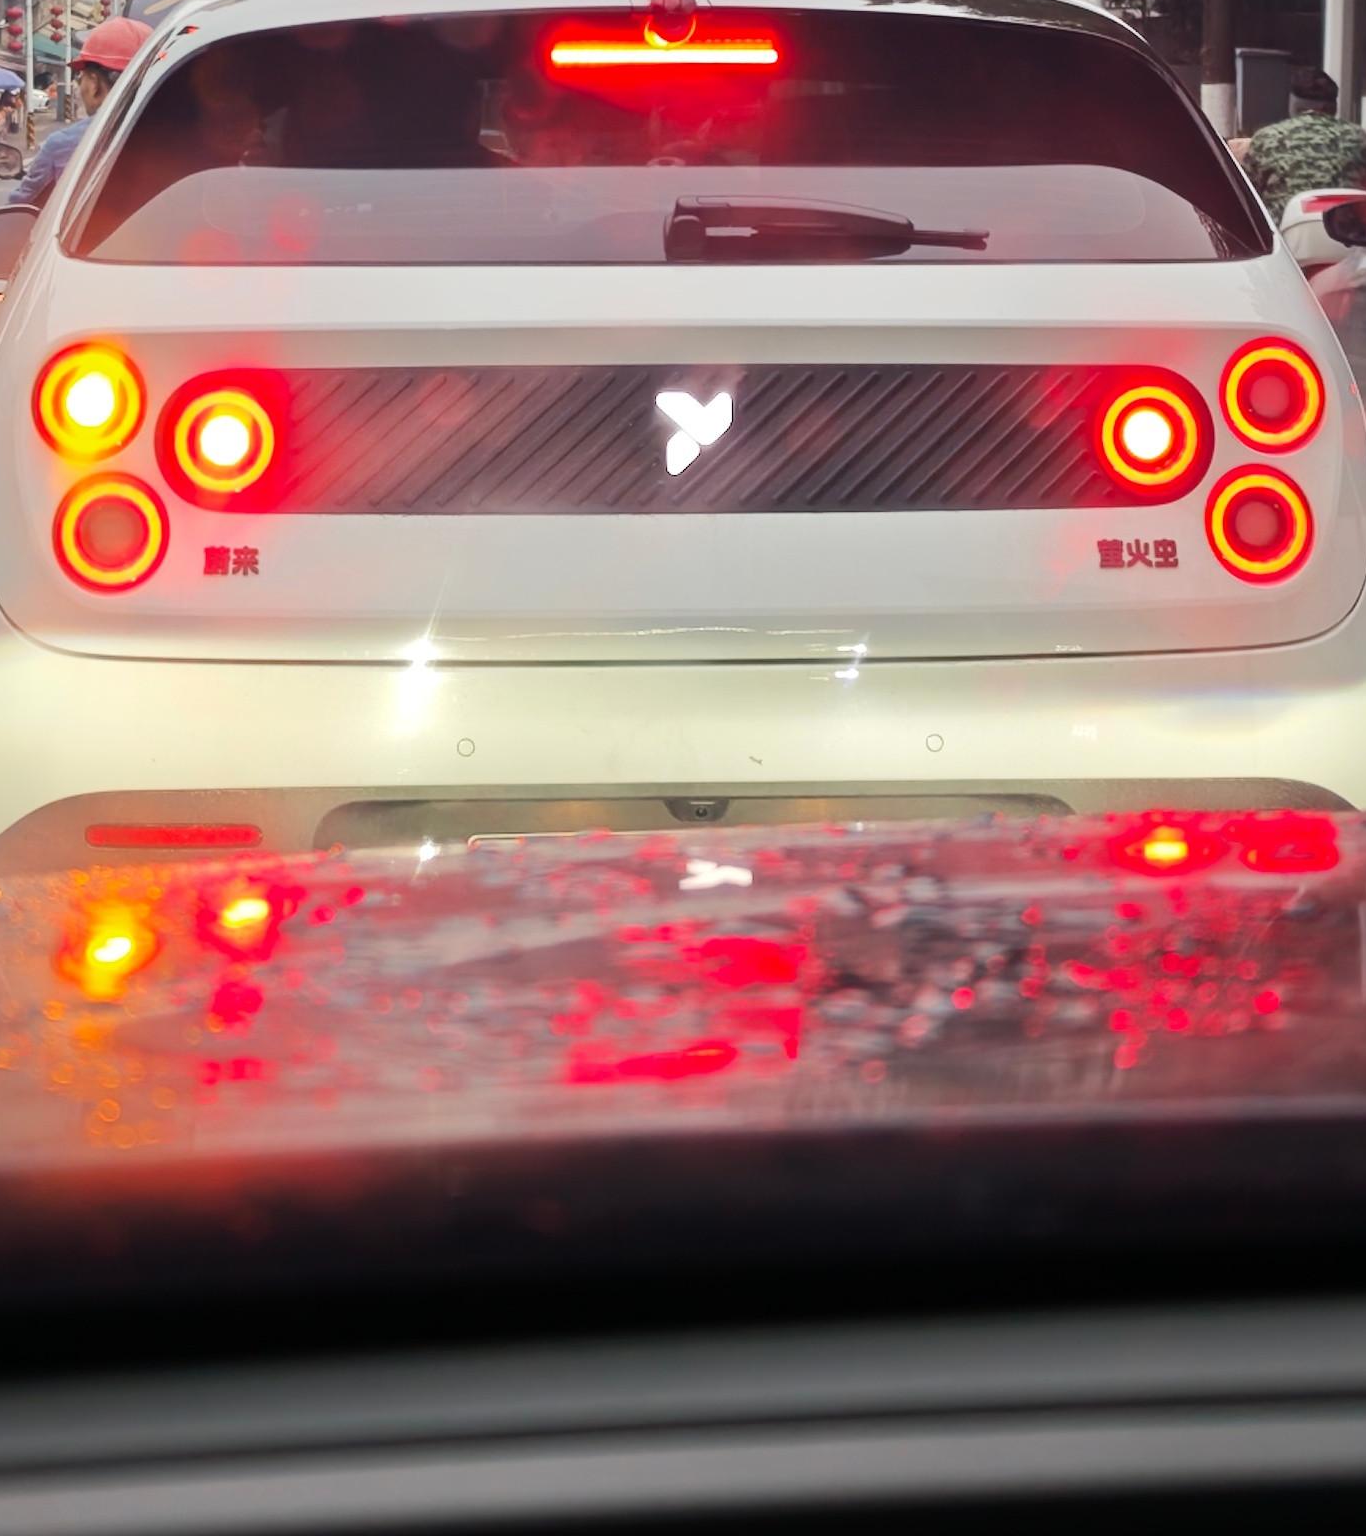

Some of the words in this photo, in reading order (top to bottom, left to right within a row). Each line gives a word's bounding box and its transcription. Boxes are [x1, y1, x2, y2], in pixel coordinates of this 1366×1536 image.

[203, 545, 259, 576] 蔚来
[1097, 538, 1179, 569] 萤火虫
